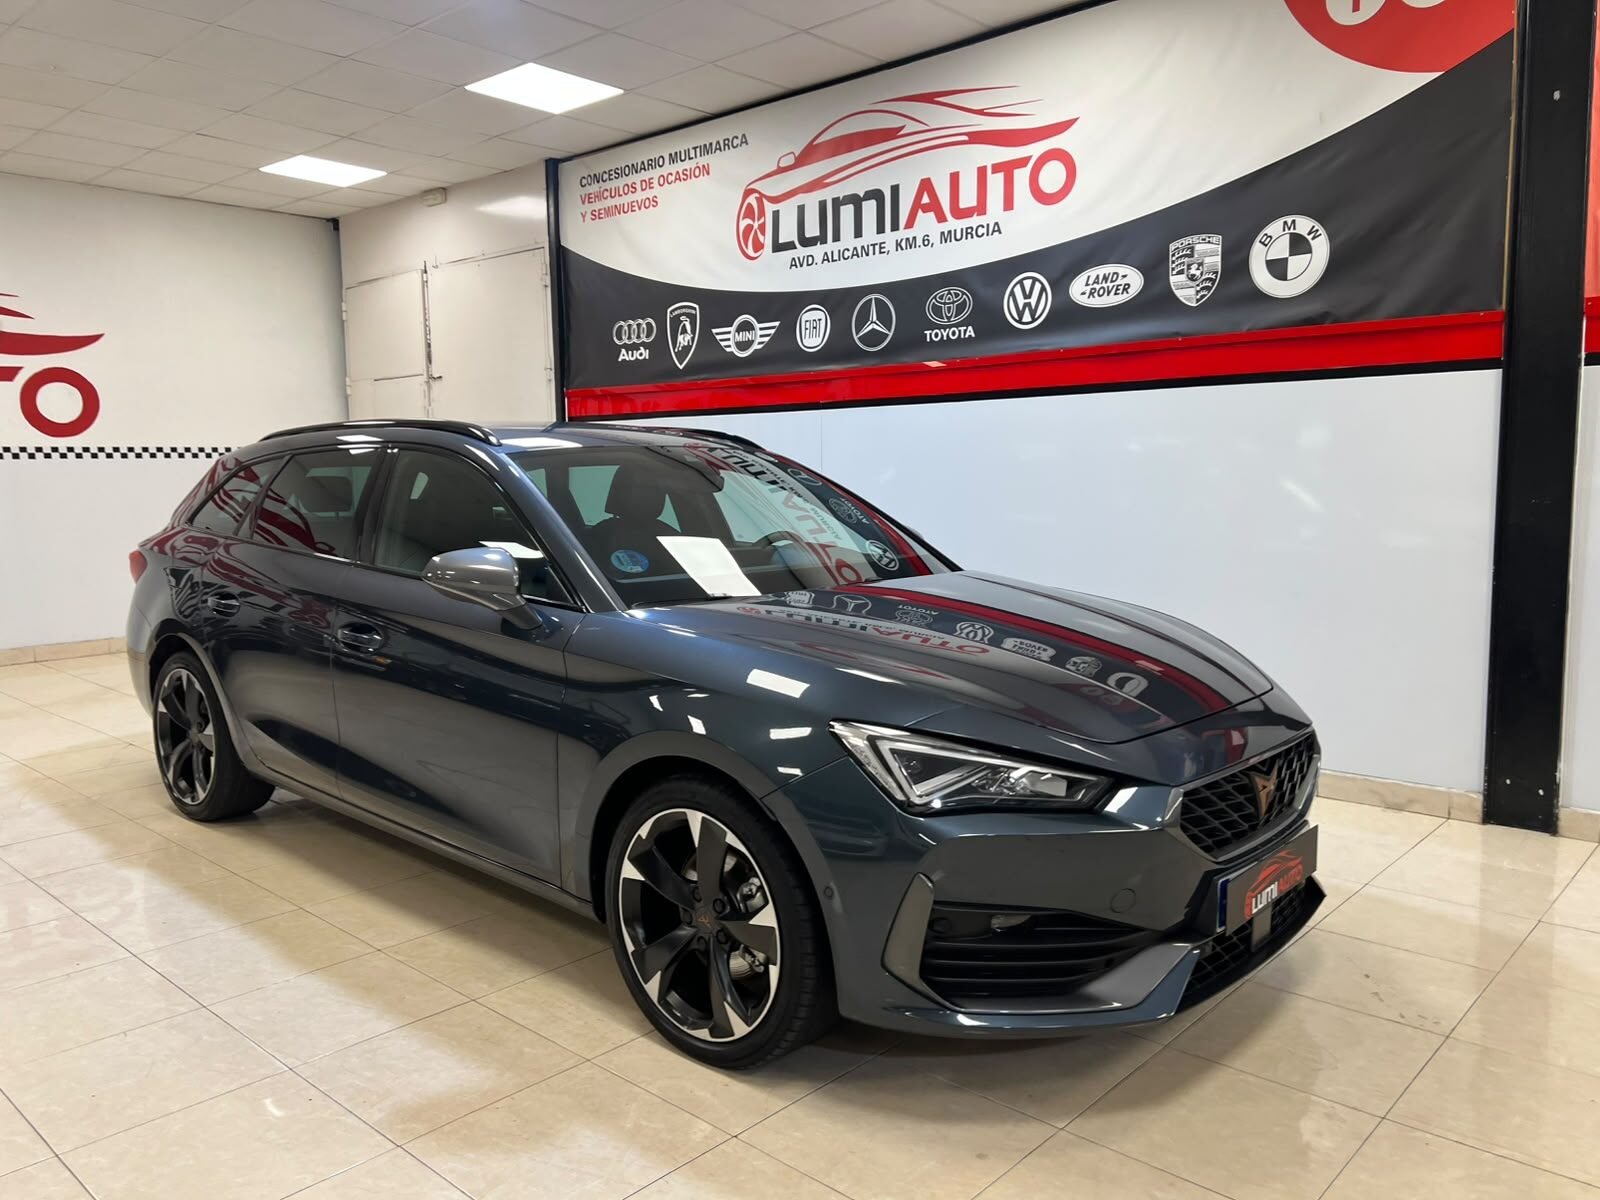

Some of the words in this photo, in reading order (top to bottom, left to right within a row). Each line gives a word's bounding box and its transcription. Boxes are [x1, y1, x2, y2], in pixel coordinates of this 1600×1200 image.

[580, 155, 665, 188] CONCESIONARIO
[668, 133, 749, 165] MULTIMARCA
[580, 181, 637, 205] VEHÍCULOS
[640, 177, 654, 192] DE
[657, 162, 710, 187] OCASIÓN
[580, 211, 588, 223] Y
[590, 195, 659, 221] SEMINUEVOS
[789, 252, 818, 269] AVD.
[821, 239, 891, 265] ALICANTE,
[939, 221, 1002, 245] MURCIA
[1171, 236, 1220, 252] PORSCHE
[734, 330, 755, 343] MINI
[804, 318, 822, 340] FIAT
[924, 326, 975, 342] TOYOTA
[617, 347, 649, 362] Audi
[0, 366, 101, 438] O
